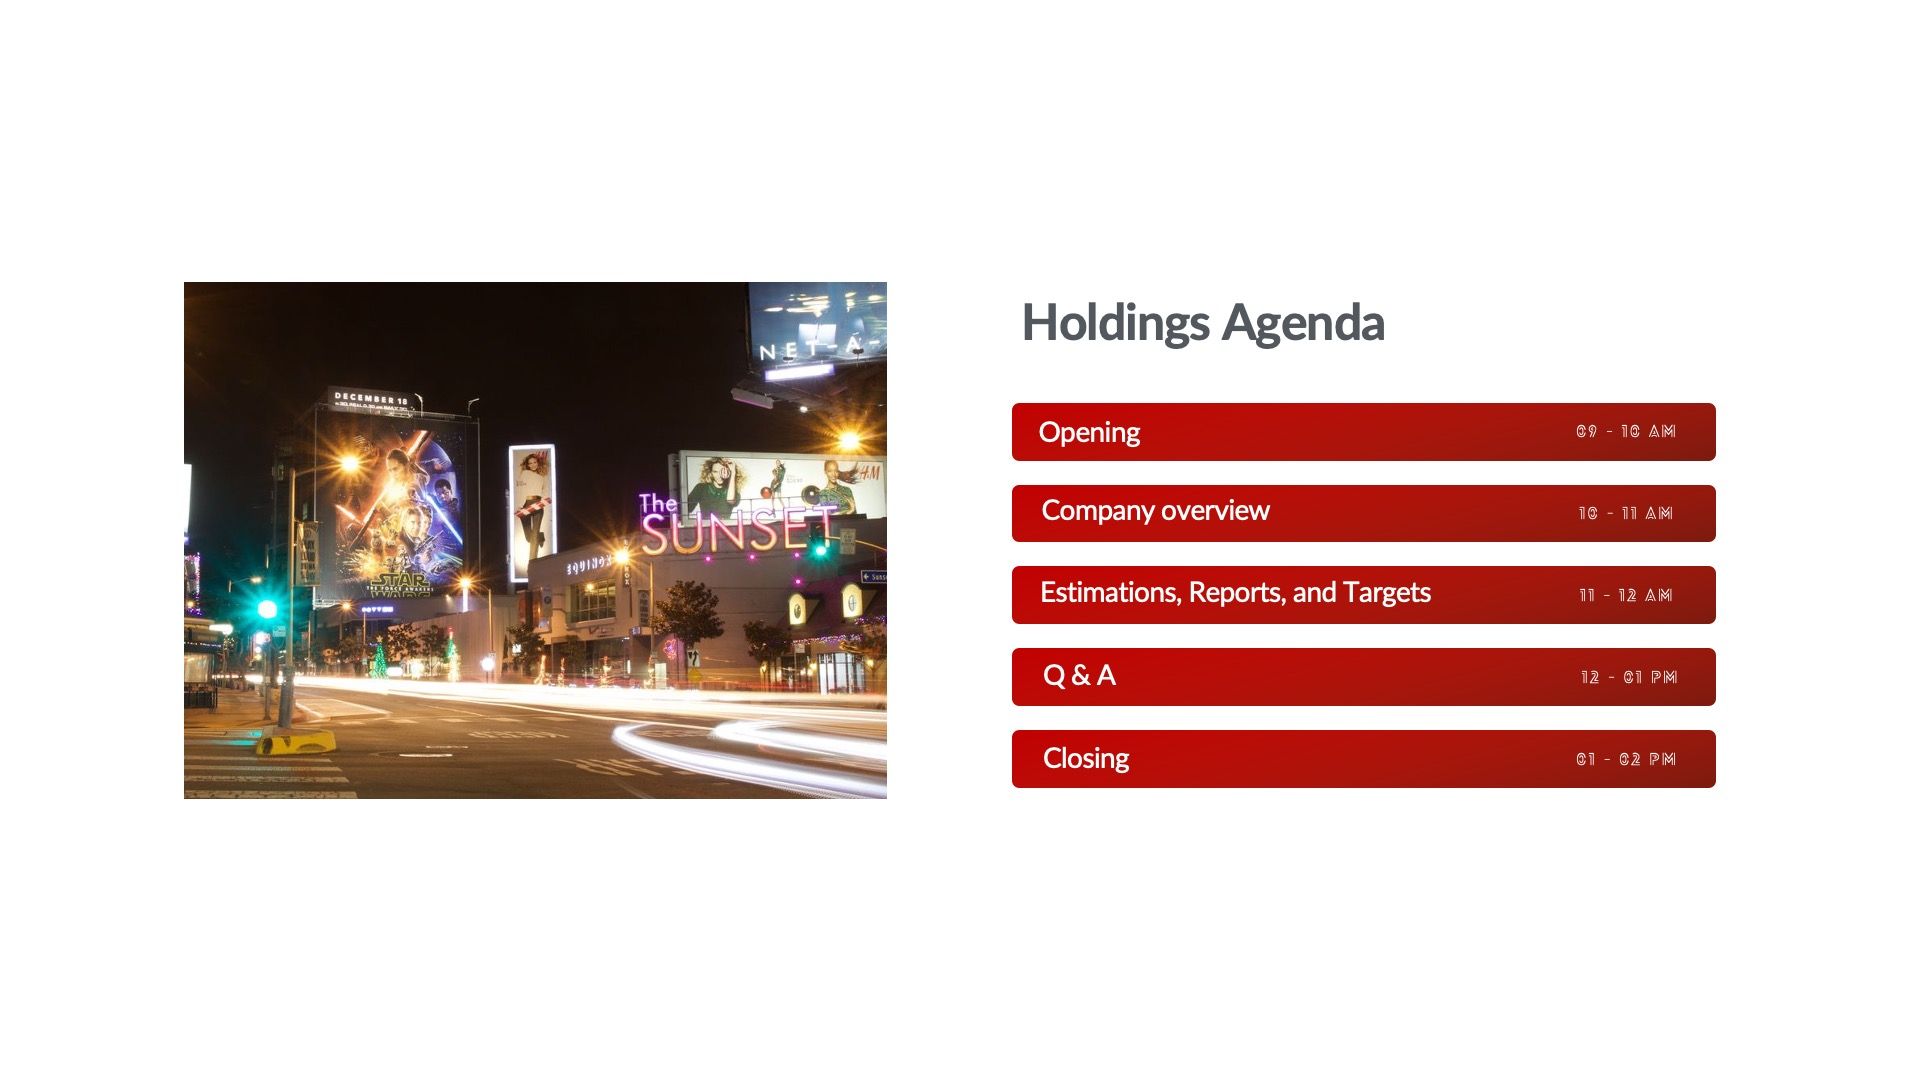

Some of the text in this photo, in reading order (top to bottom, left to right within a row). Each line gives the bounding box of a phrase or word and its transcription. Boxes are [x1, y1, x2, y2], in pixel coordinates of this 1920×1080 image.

[334, 391, 408, 405] DECEMBER 18
[639, 493, 678, 513] The
[642, 505, 838, 556] SUNSET
[566, 554, 613, 576] EQUINOX
[370, 573, 430, 587] STAR
